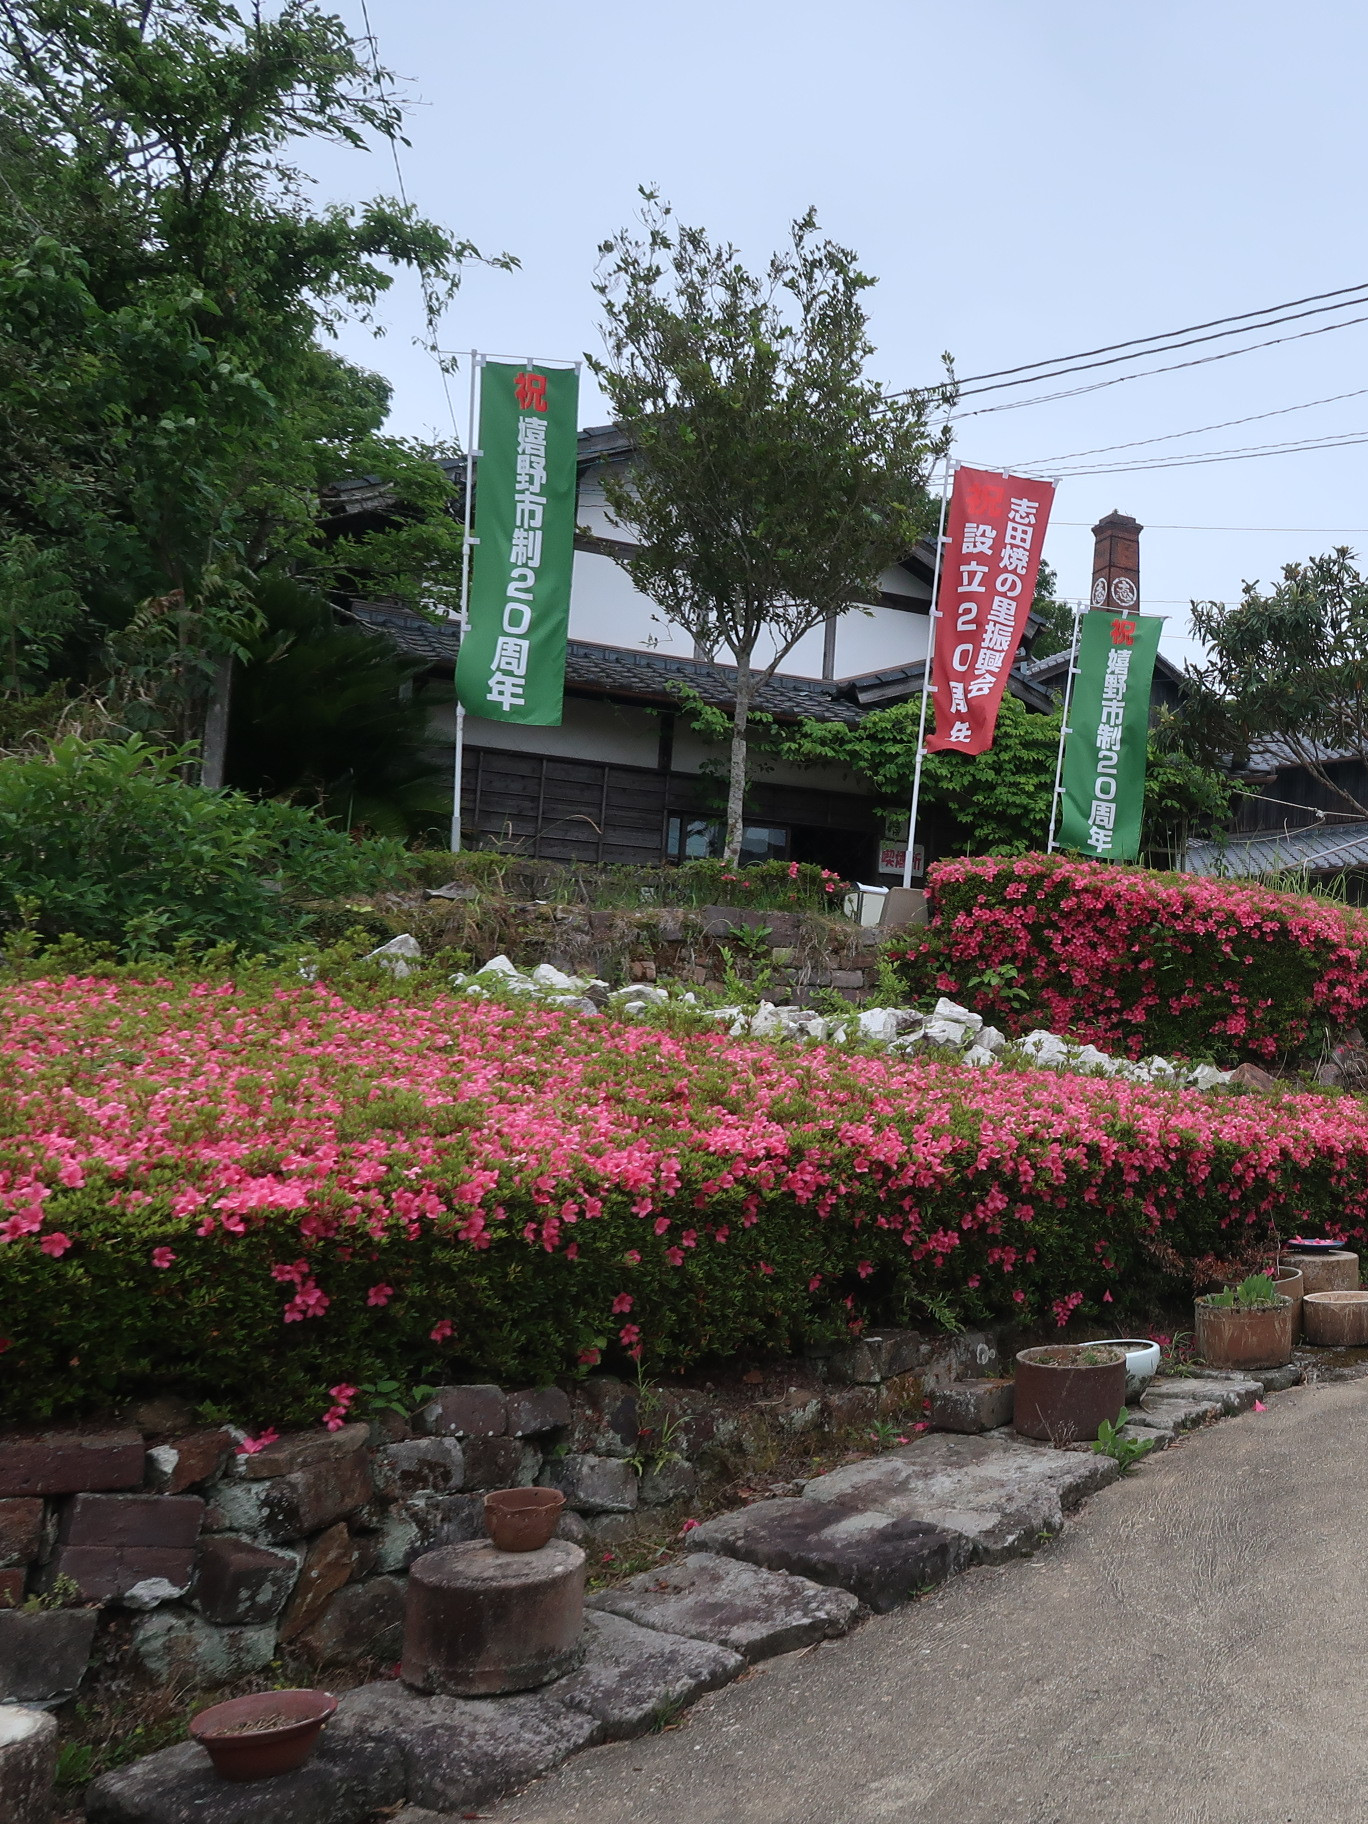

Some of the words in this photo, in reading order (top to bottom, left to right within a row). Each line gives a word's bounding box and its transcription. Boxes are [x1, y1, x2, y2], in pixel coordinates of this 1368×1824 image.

[513, 371, 548, 412] 祝
[966, 481, 1005, 517] 祝
[486, 416, 548, 712] 嬉野市制20周年
[967, 497, 1040, 699] 志田焼の里振興会
[1109, 618, 1136, 646] 祝
[1087, 649, 1133, 853] 嬉野市制20周年
